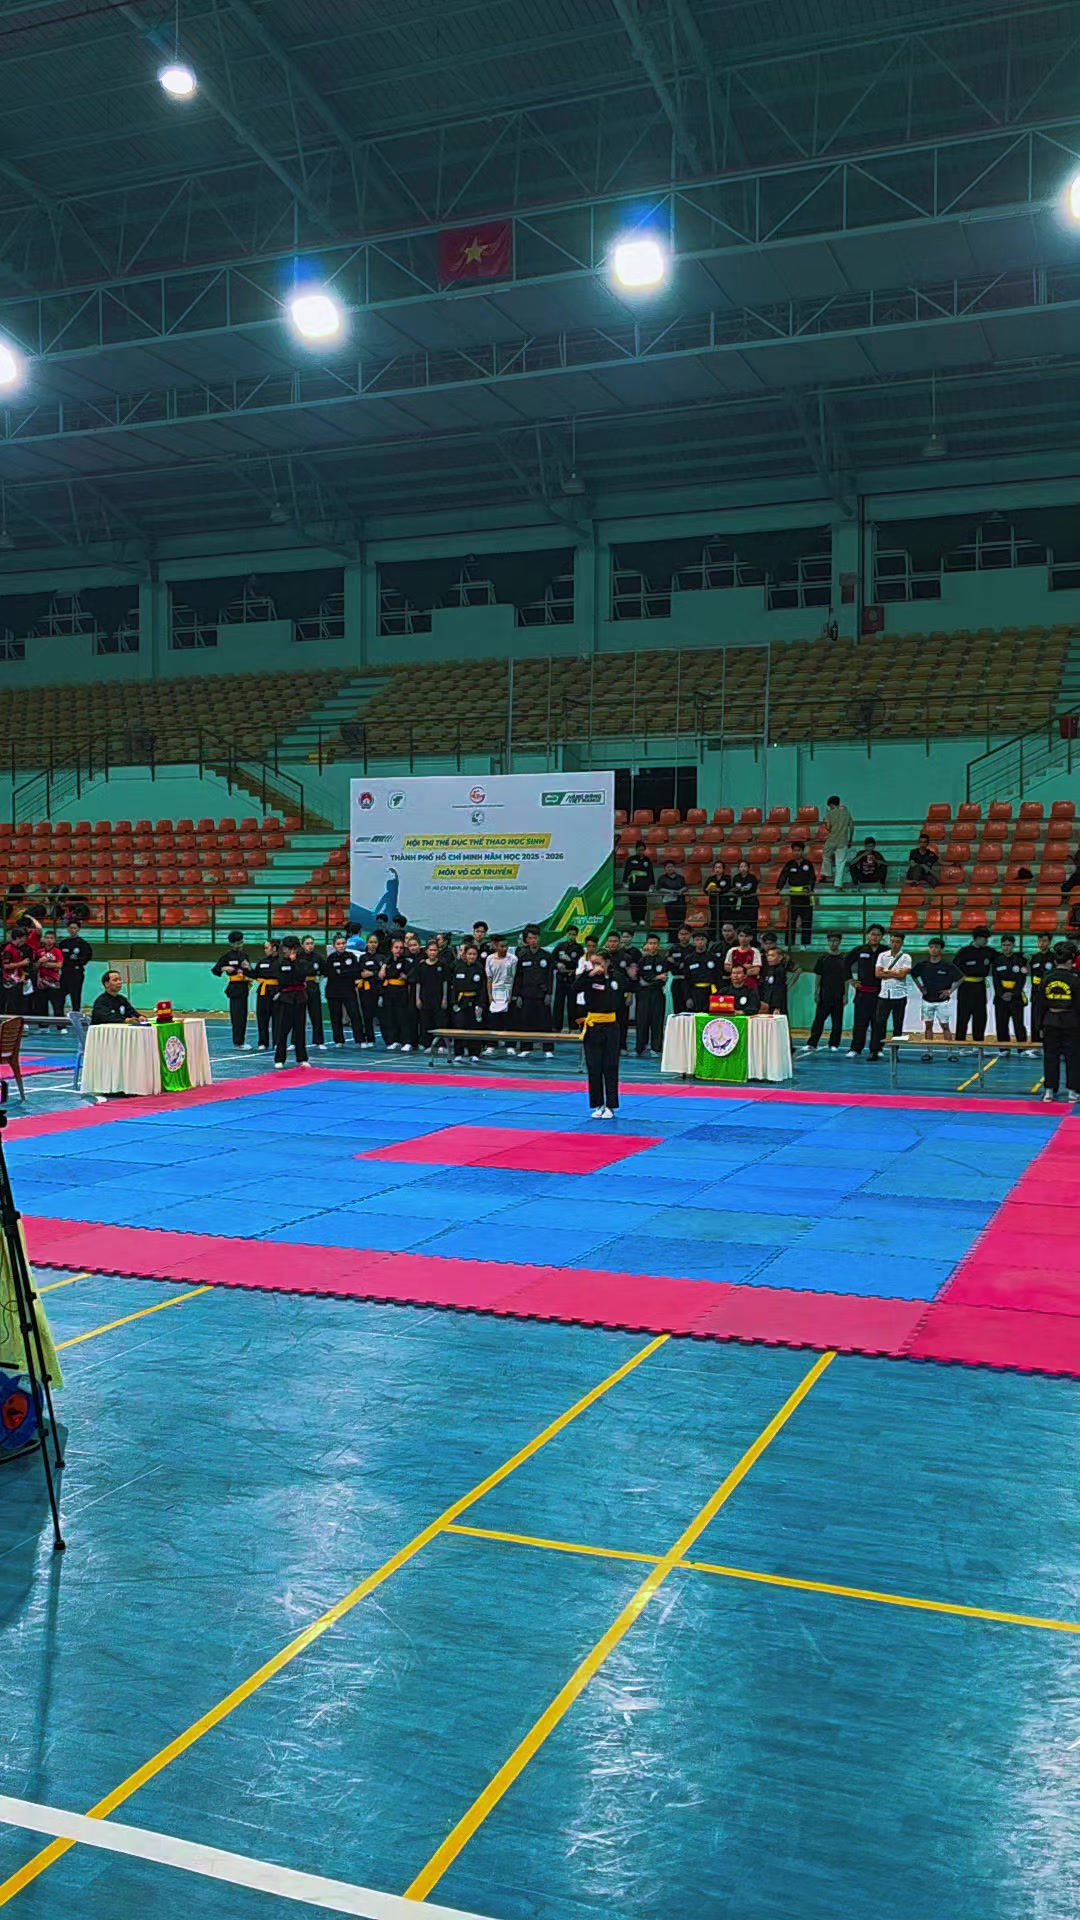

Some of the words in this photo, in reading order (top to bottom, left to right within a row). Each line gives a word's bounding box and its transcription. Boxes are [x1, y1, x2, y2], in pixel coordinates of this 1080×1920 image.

[406, 839, 420, 847] HỘI
[451, 839, 467, 847] DỤC
[508, 838, 524, 846] HỌC
[391, 853, 416, 861] THÀNH
[418, 852, 434, 861] PHỐ
[448, 852, 462, 861] CHÍ
[463, 853, 483, 861] MINH
[484, 852, 502, 860] NĂM
[504, 853, 520, 861] HỌC
